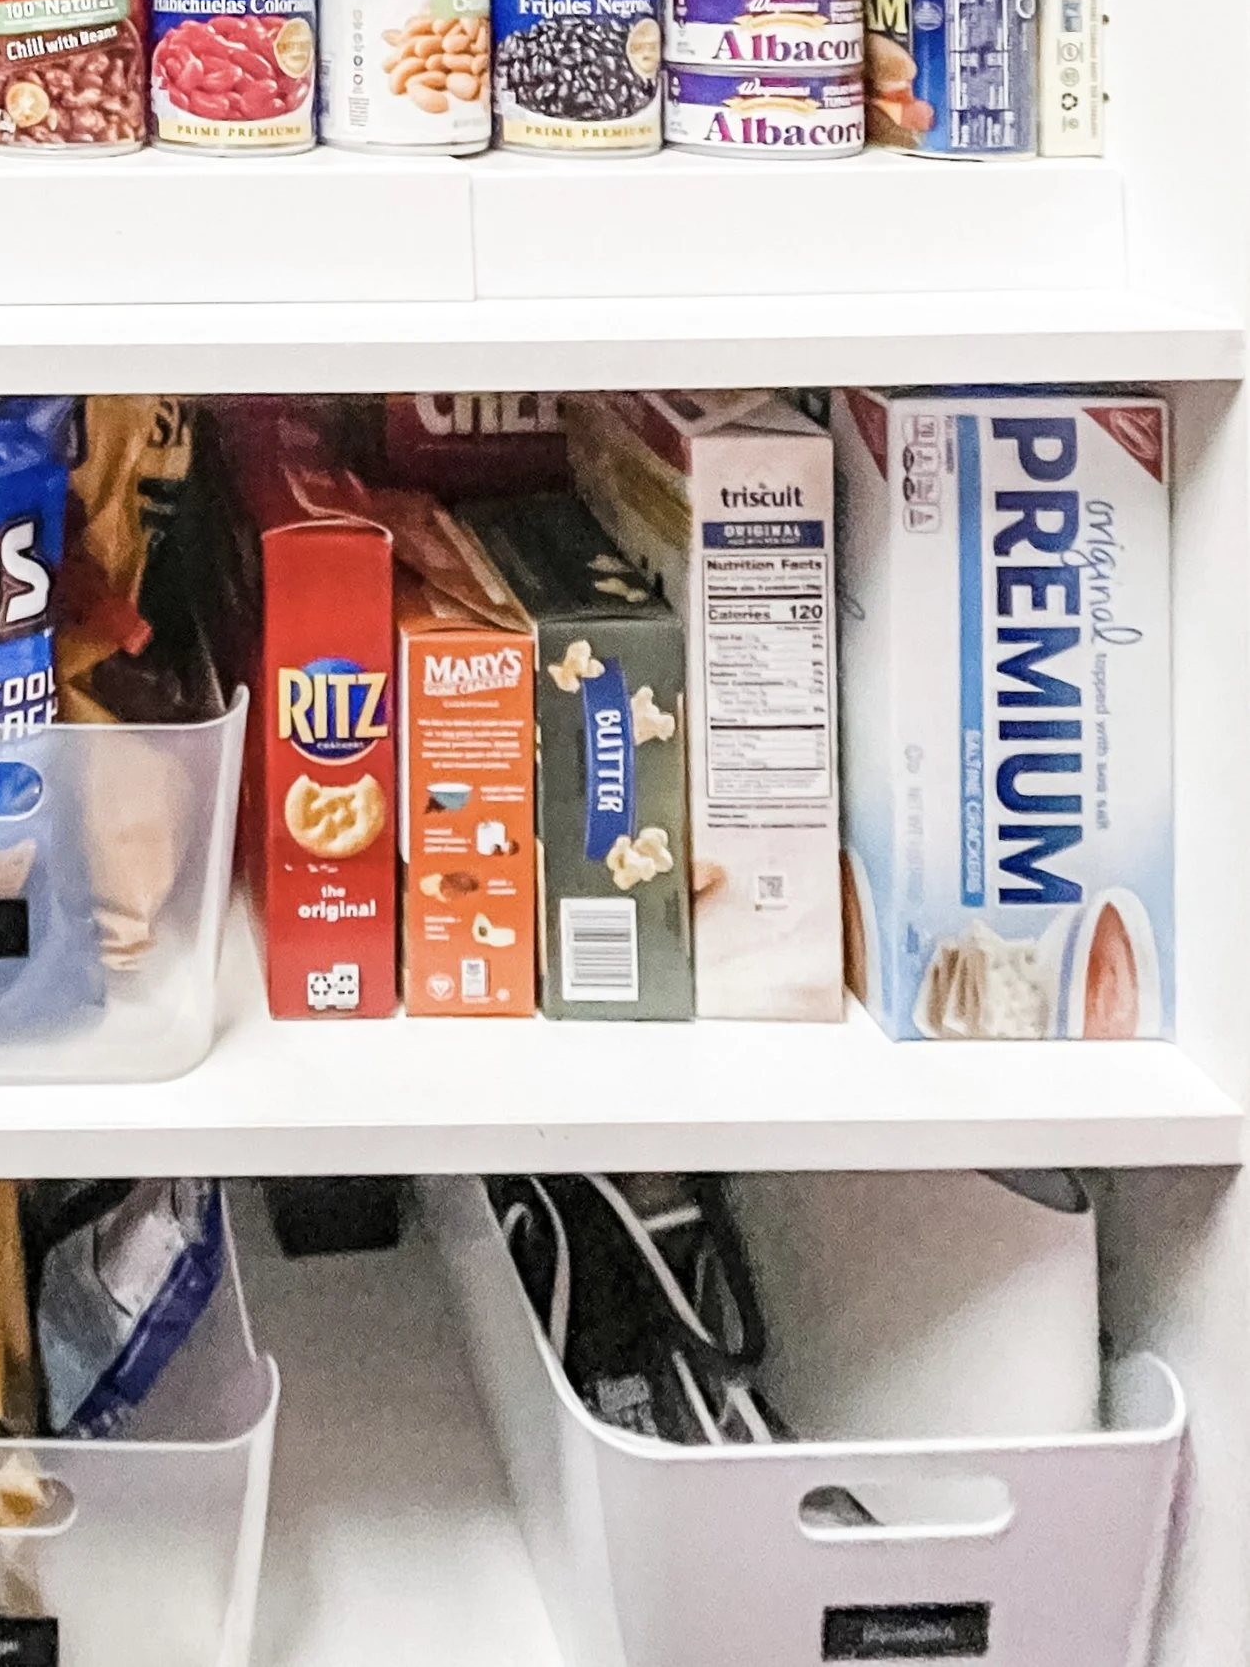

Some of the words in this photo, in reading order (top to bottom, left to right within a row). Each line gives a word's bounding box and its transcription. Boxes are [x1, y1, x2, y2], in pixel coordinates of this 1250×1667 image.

[6, 35, 44, 62] Chili
[46, 33, 79, 53] with
[80, 24, 118, 46] Beans
[176, 123, 222, 137] PRIME
[525, 125, 573, 138] PRIME
[720, 484, 804, 508] triscuit
[723, 524, 802, 537] ORIGINAL
[707, 559, 775, 570] Nutrition
[780, 559, 823, 570] Facts
[1061, 498, 1144, 647] original
[708, 609, 772, 620] Calories
[790, 604, 823, 619] 120
[424, 647, 523, 683] MARY'S
[991, 416, 1084, 907] PREMIUM
[1091, 652, 1112, 716] topped
[278, 665, 388, 744] RITZ
[1095, 720, 1110, 757] with
[594, 708, 624, 815] BUTTER
[964, 729, 983, 799] SALTINE
[1095, 762, 1107, 793] sea
[1095, 799, 1111, 832] salt
[964, 800, 983, 894] CRACKERS
[320, 885, 346, 899] the
[297, 899, 376, 922] original
